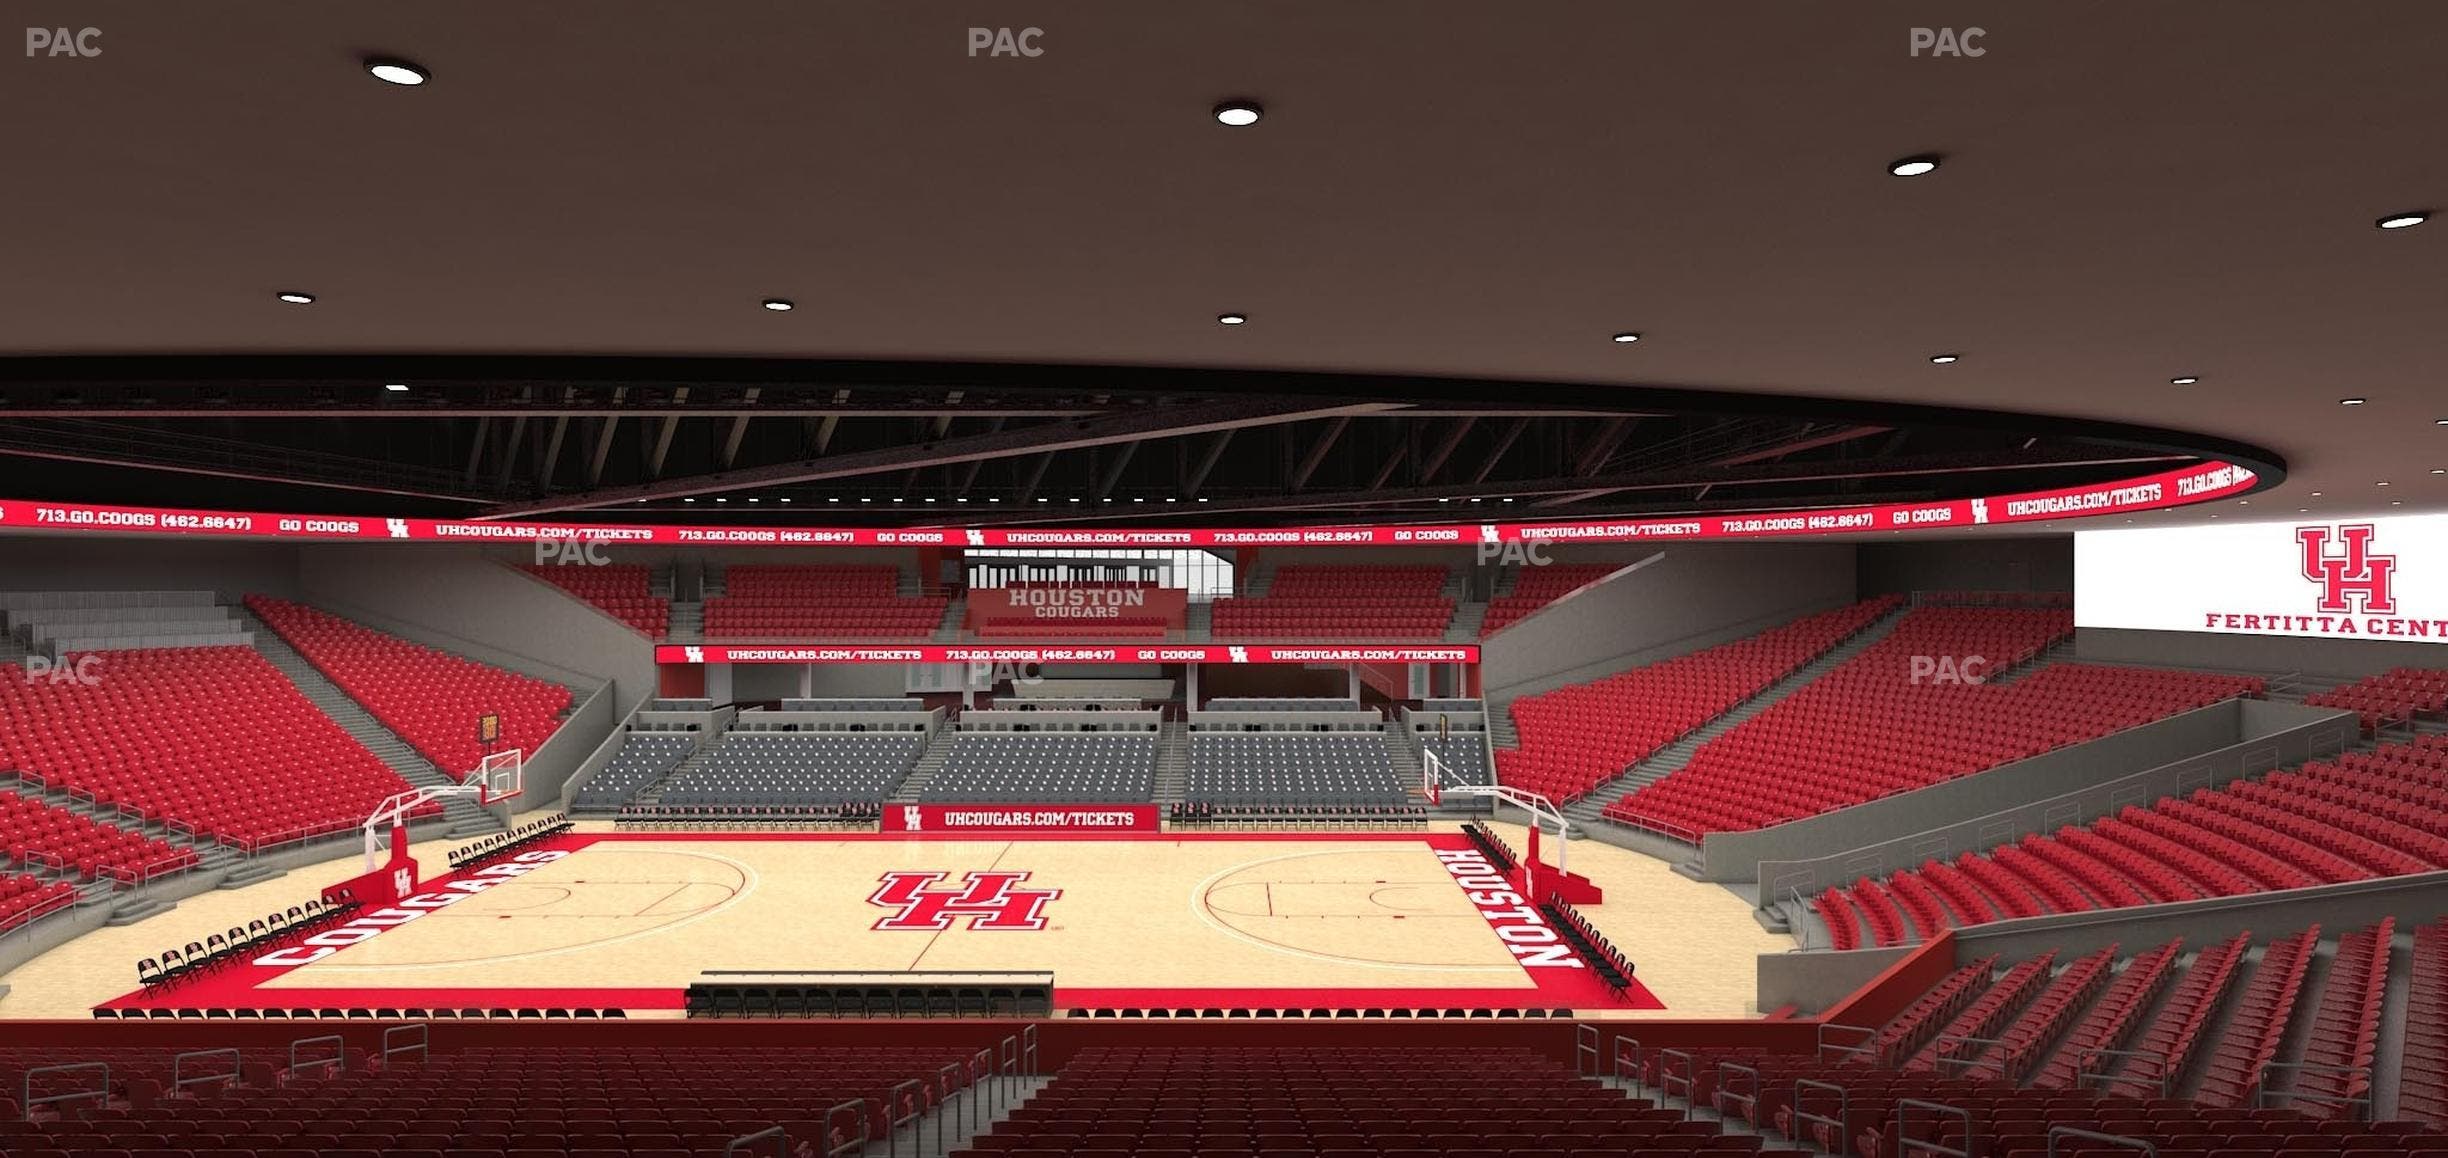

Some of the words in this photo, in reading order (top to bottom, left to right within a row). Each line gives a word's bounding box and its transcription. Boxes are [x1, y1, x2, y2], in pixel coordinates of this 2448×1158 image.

[2006, 483, 2163, 516] UHCOUGARS.COM/TICKETS
[36, 508, 156, 527] 713.GO.COOGS
[1892, 511, 1908, 525] GO
[1912, 507, 1952, 523] COOGS
[279, 519, 301, 531] GO
[305, 520, 360, 533] COOGS
[435, 524, 653, 540] UHCOUGARS.COM/TICKETS
[876, 532, 896, 543] GO
[899, 532, 944, 543] COOGS
[1394, 530, 1412, 541] GO
[1415, 530, 1459, 540] COOGS
[2296, 523, 2396, 615] UH
[1009, 588, 1145, 606] HOUSTON
[1035, 606, 1120, 618] COUGARS
[2205, 612, 2358, 634] FERTITTA
[2366, 617, 2448, 637] CENT
[1137, 650, 1156, 660] GO
[1160, 650, 1206, 660] COOGS
[944, 812, 1135, 827] UHCOUGARS.COM/TICKETS
[252, 849, 571, 966] COUGARS
[865, 871, 1064, 931] UH
[1433, 849, 1586, 969] HOUSTON
